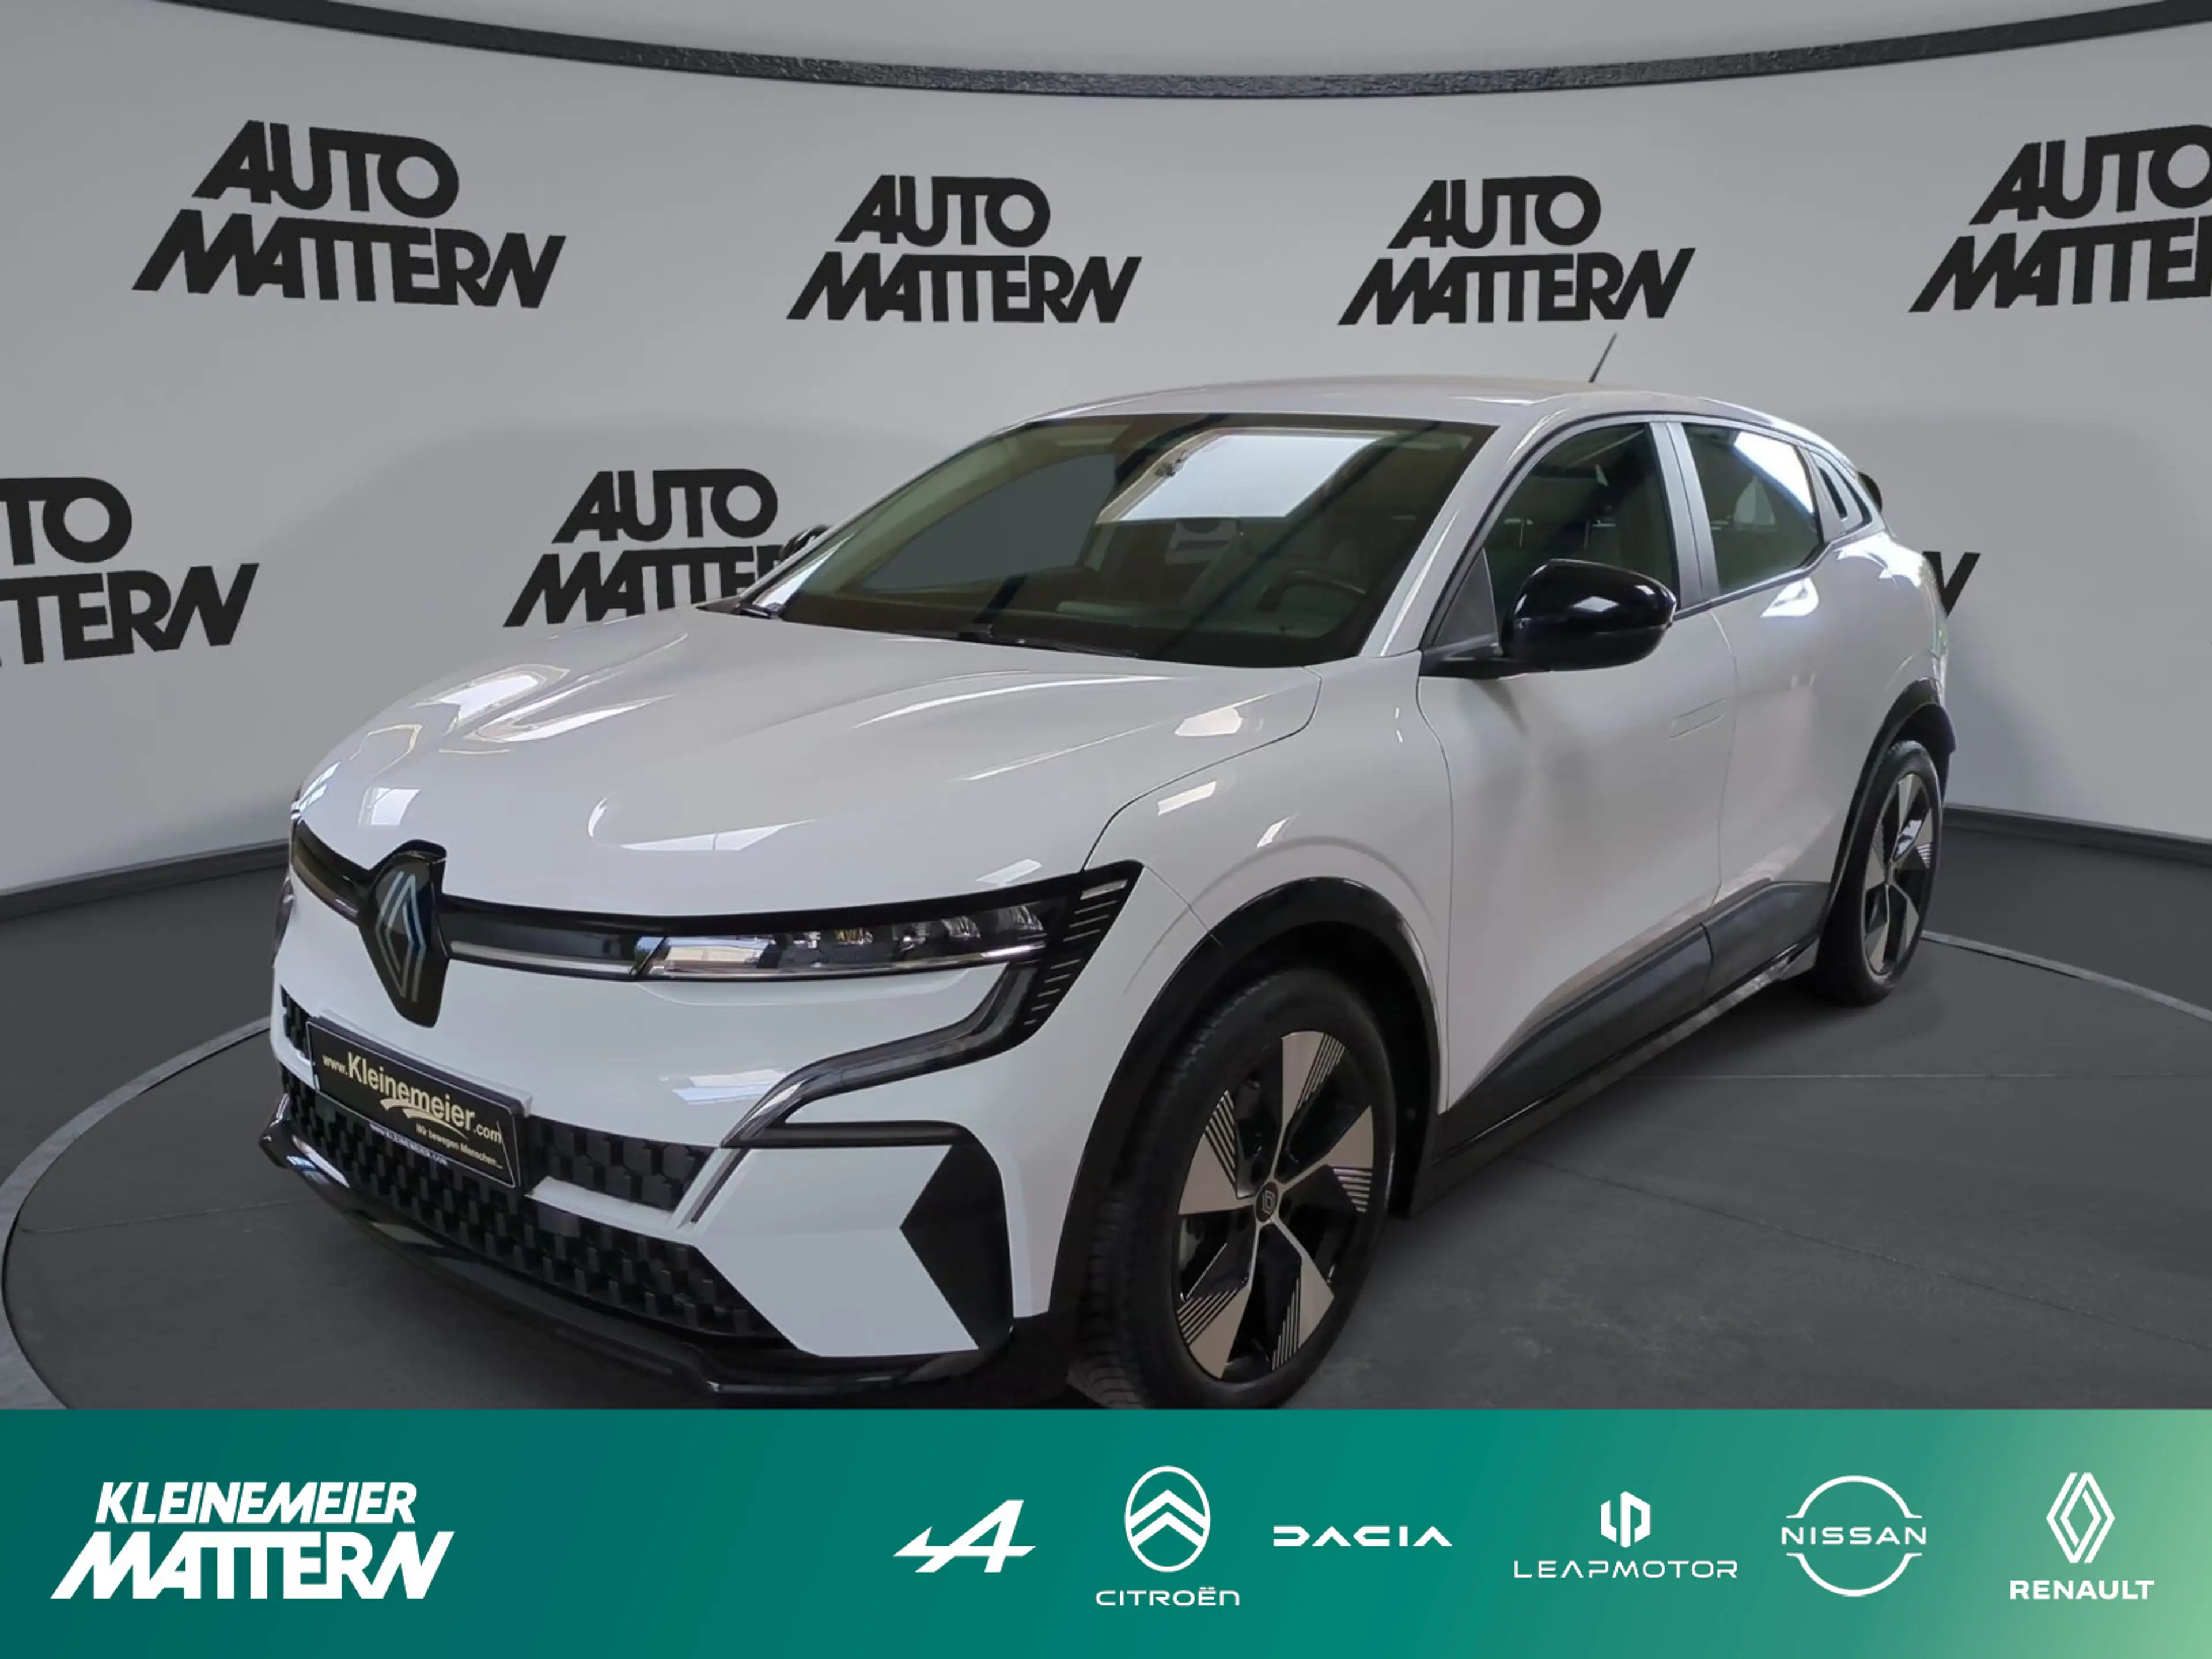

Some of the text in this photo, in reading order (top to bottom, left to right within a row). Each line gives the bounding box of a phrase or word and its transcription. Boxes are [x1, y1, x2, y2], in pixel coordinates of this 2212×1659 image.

[191, 120, 459, 219] AUTO
[835, 175, 1051, 248] AUTO
[1387, 175, 1601, 249] AUTO
[1969, 124, 2212, 225] AUTO
[132, 209, 566, 308] MATTERN
[787, 251, 1142, 323] MATTERN
[1338, 248, 1695, 325] MATTERN
[1909, 215, 2212, 313] MATTE
[552, 468, 778, 544] AUTO
[321, 1051, 502, 1145] www.Kleinemeier.com
